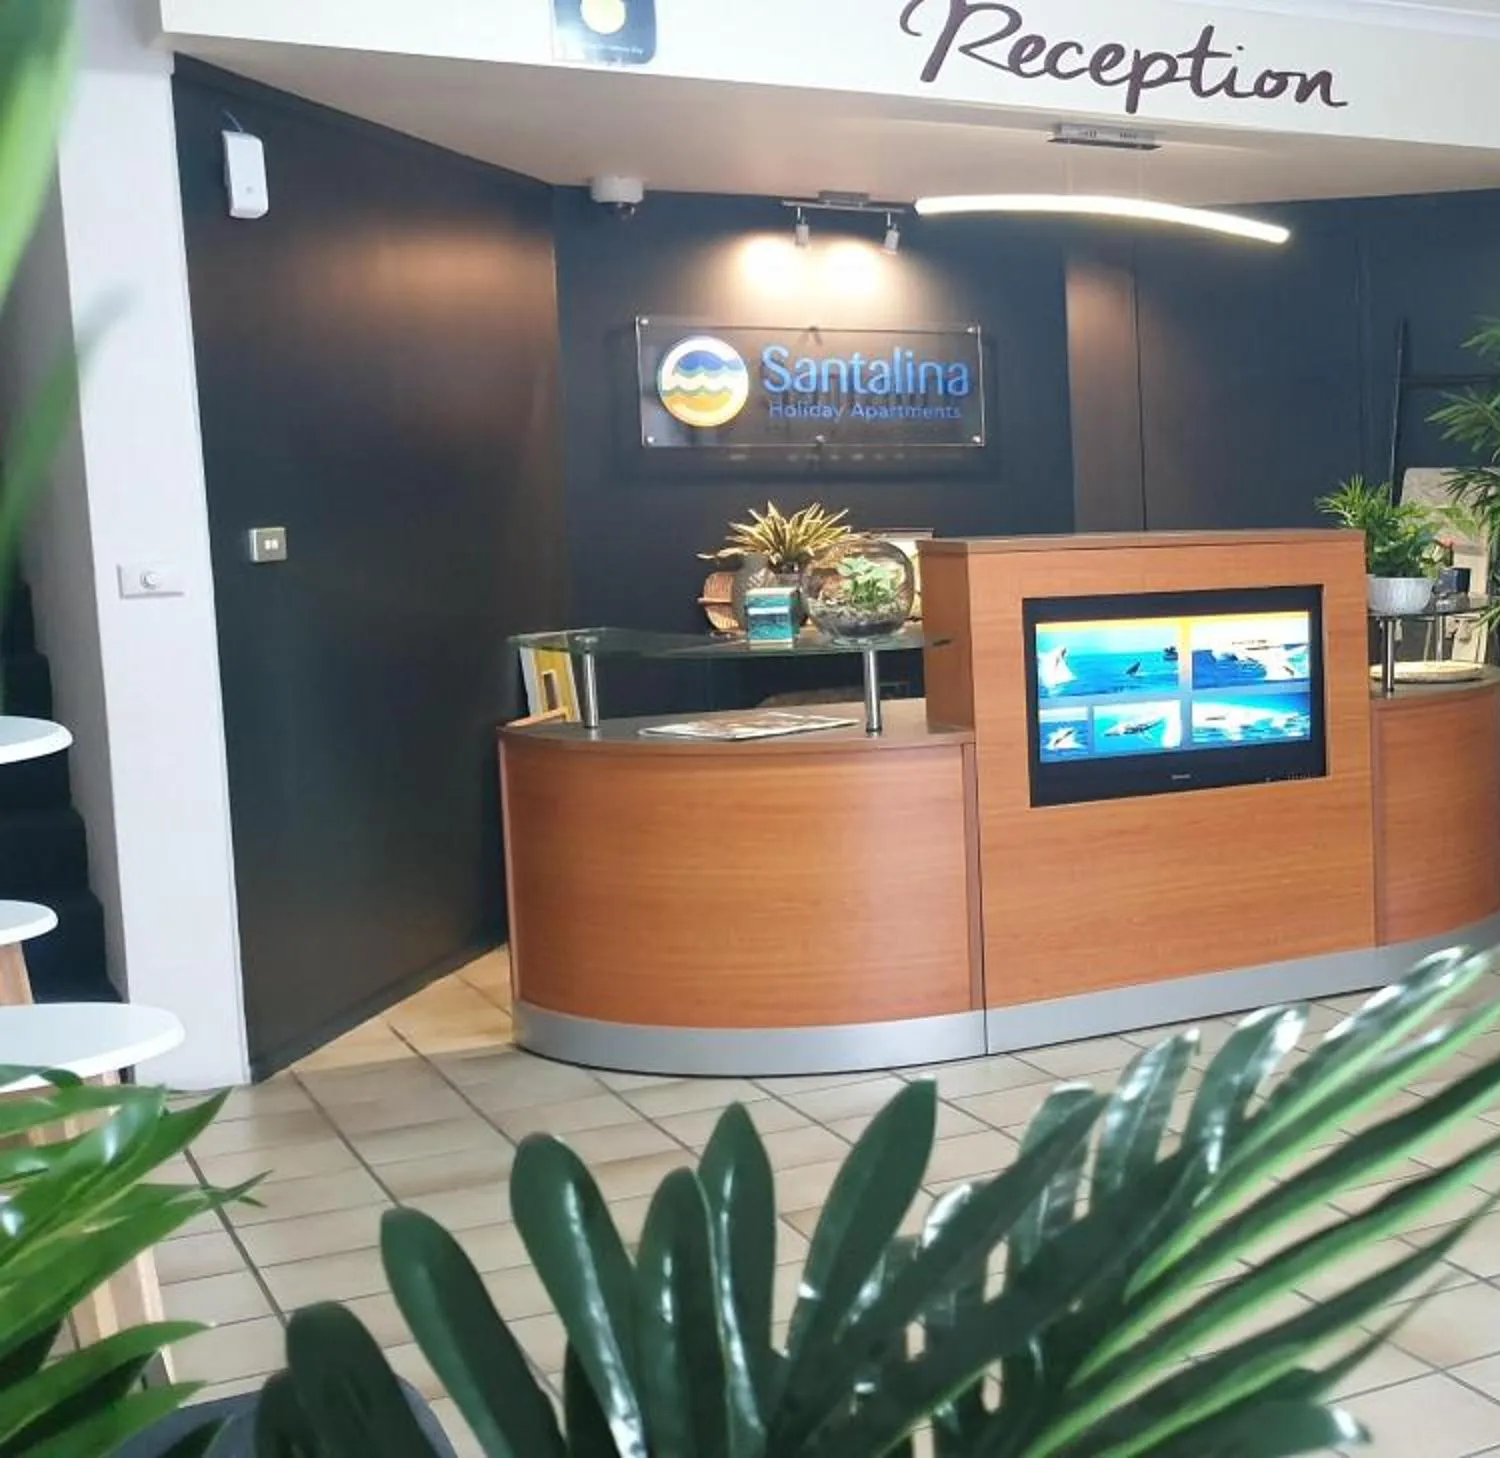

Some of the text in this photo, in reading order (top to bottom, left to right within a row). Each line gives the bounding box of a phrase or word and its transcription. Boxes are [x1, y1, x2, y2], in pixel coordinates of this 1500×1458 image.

[900, 0, 1348, 114] Reception
[761, 345, 971, 396] Santalina
[769, 401, 962, 424] Holiday Apartments
